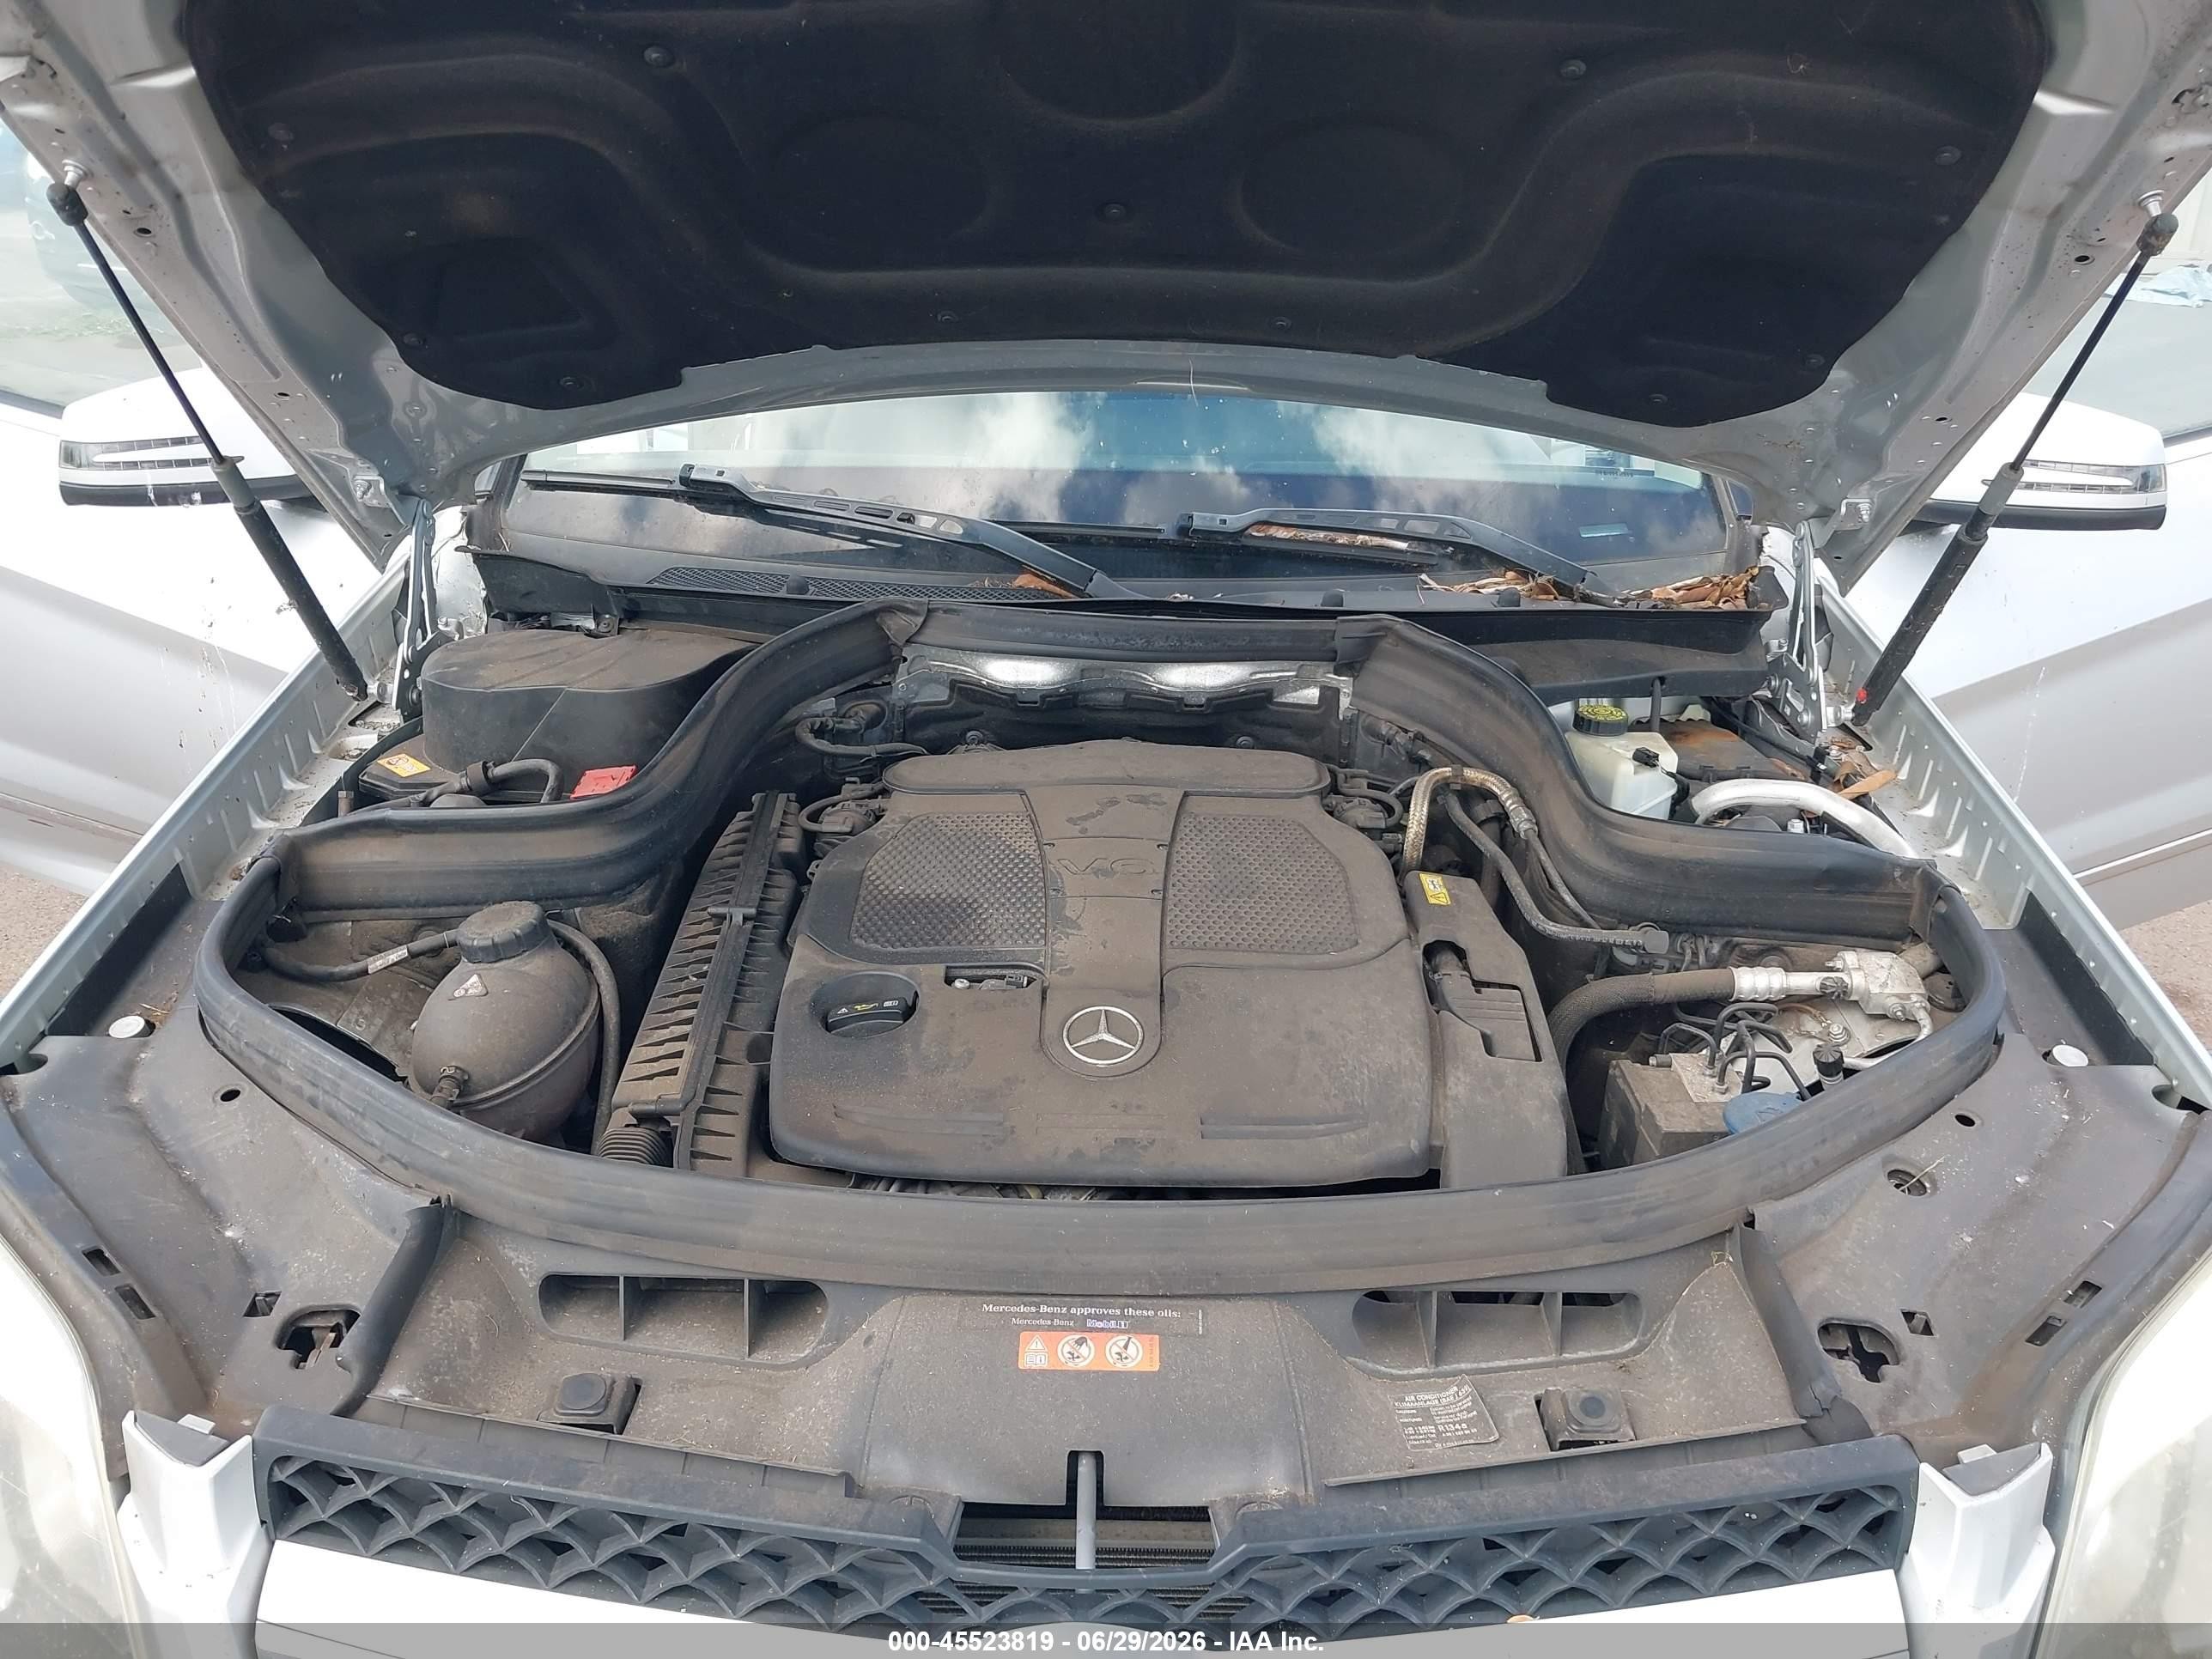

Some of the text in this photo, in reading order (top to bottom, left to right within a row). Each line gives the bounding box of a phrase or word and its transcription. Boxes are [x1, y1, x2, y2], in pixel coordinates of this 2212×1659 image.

[981, 1304, 1182, 1318] Mercedes-Benz approves these oils:
[1012, 1317, 1074, 1327] Mercedes-Benz
[1086, 1318, 1116, 1328] Mobil
[1416, 1386, 1459, 1401] CONDITIONER
